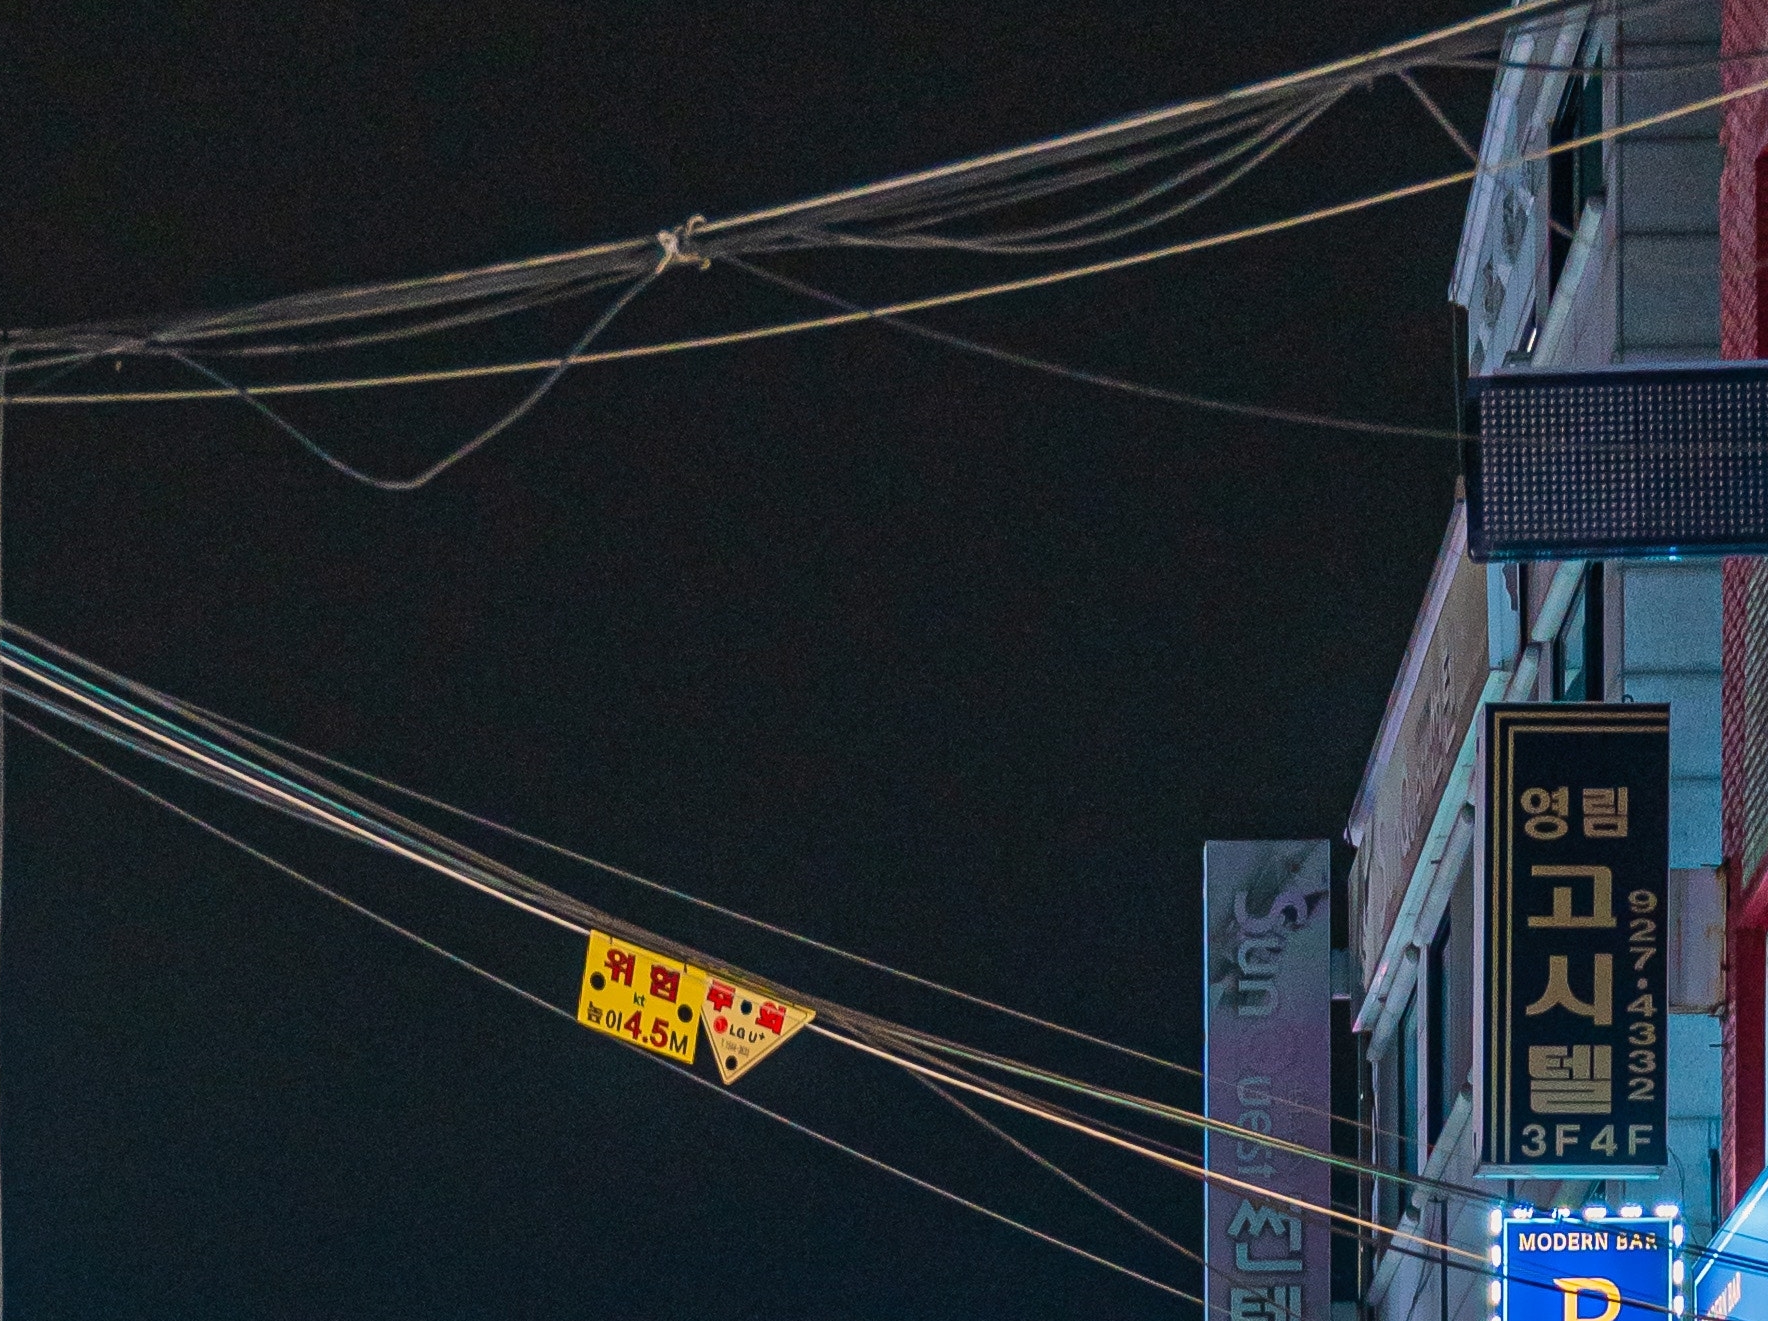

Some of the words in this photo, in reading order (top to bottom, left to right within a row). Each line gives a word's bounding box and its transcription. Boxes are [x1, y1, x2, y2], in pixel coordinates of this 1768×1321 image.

[603, 948, 681, 1004] 위험
[1524, 864, 1617, 1115] 고시텔
[1518, 1231, 1609, 1252] MODERN
[1617, 1233, 1658, 1251] BAR
